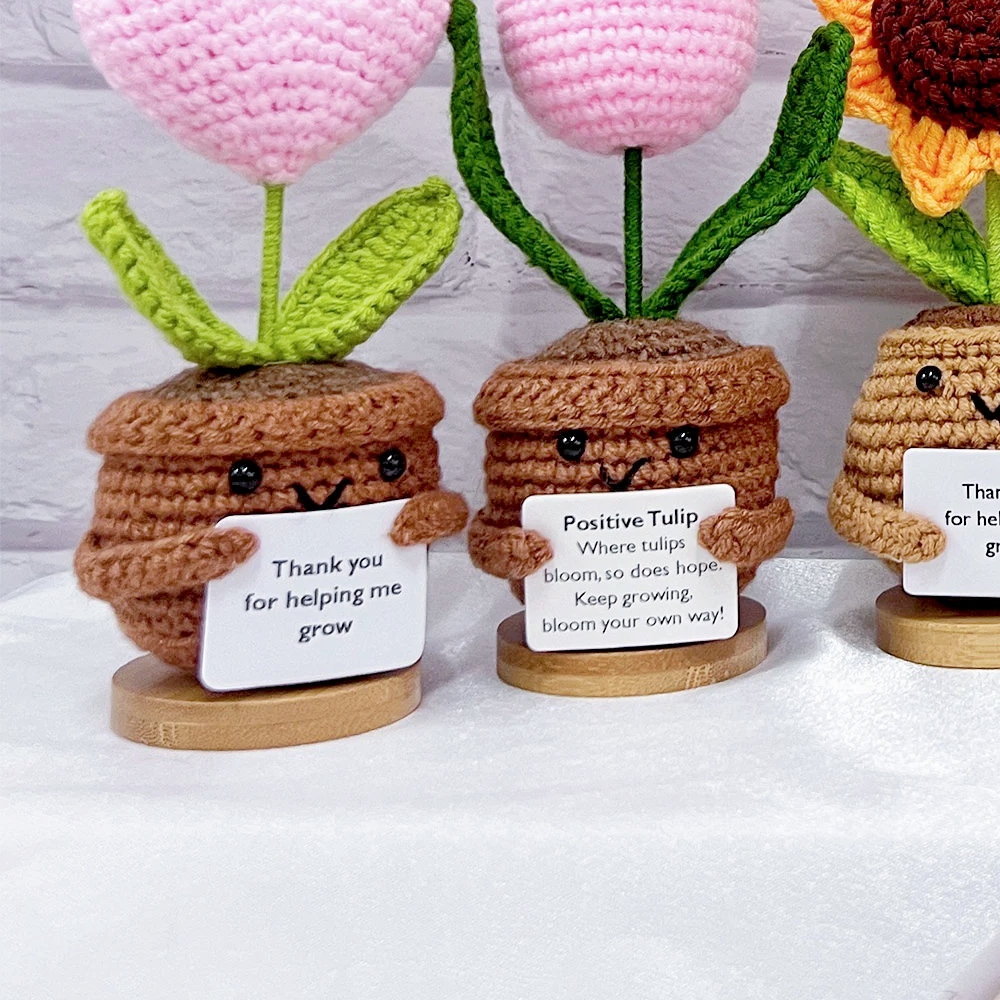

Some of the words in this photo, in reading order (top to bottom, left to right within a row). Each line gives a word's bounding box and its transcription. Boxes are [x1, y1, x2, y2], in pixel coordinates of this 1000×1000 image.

[563, 513, 644, 532] Positive
[647, 508, 698, 529] Tulip
[944, 510, 971, 526] for
[576, 539, 637, 555] Where
[641, 535, 686, 555] tulips
[272, 555, 344, 579] Thank
[348, 553, 383, 576] you
[543, 568, 602, 583] bloom,
[605, 570, 624, 580] so
[630, 564, 670, 578] does
[676, 559, 723, 576] hope.
[244, 592, 280, 611] for
[286, 586, 364, 611] helping
[370, 582, 402, 599] me
[574, 590, 618, 610] Keep
[622, 587, 693, 608] growing,
[298, 619, 353, 643] grow
[542, 617, 596, 633] bloom
[600, 616, 640, 634] your
[646, 613, 682, 627] own
[688, 606, 725, 626] way!
